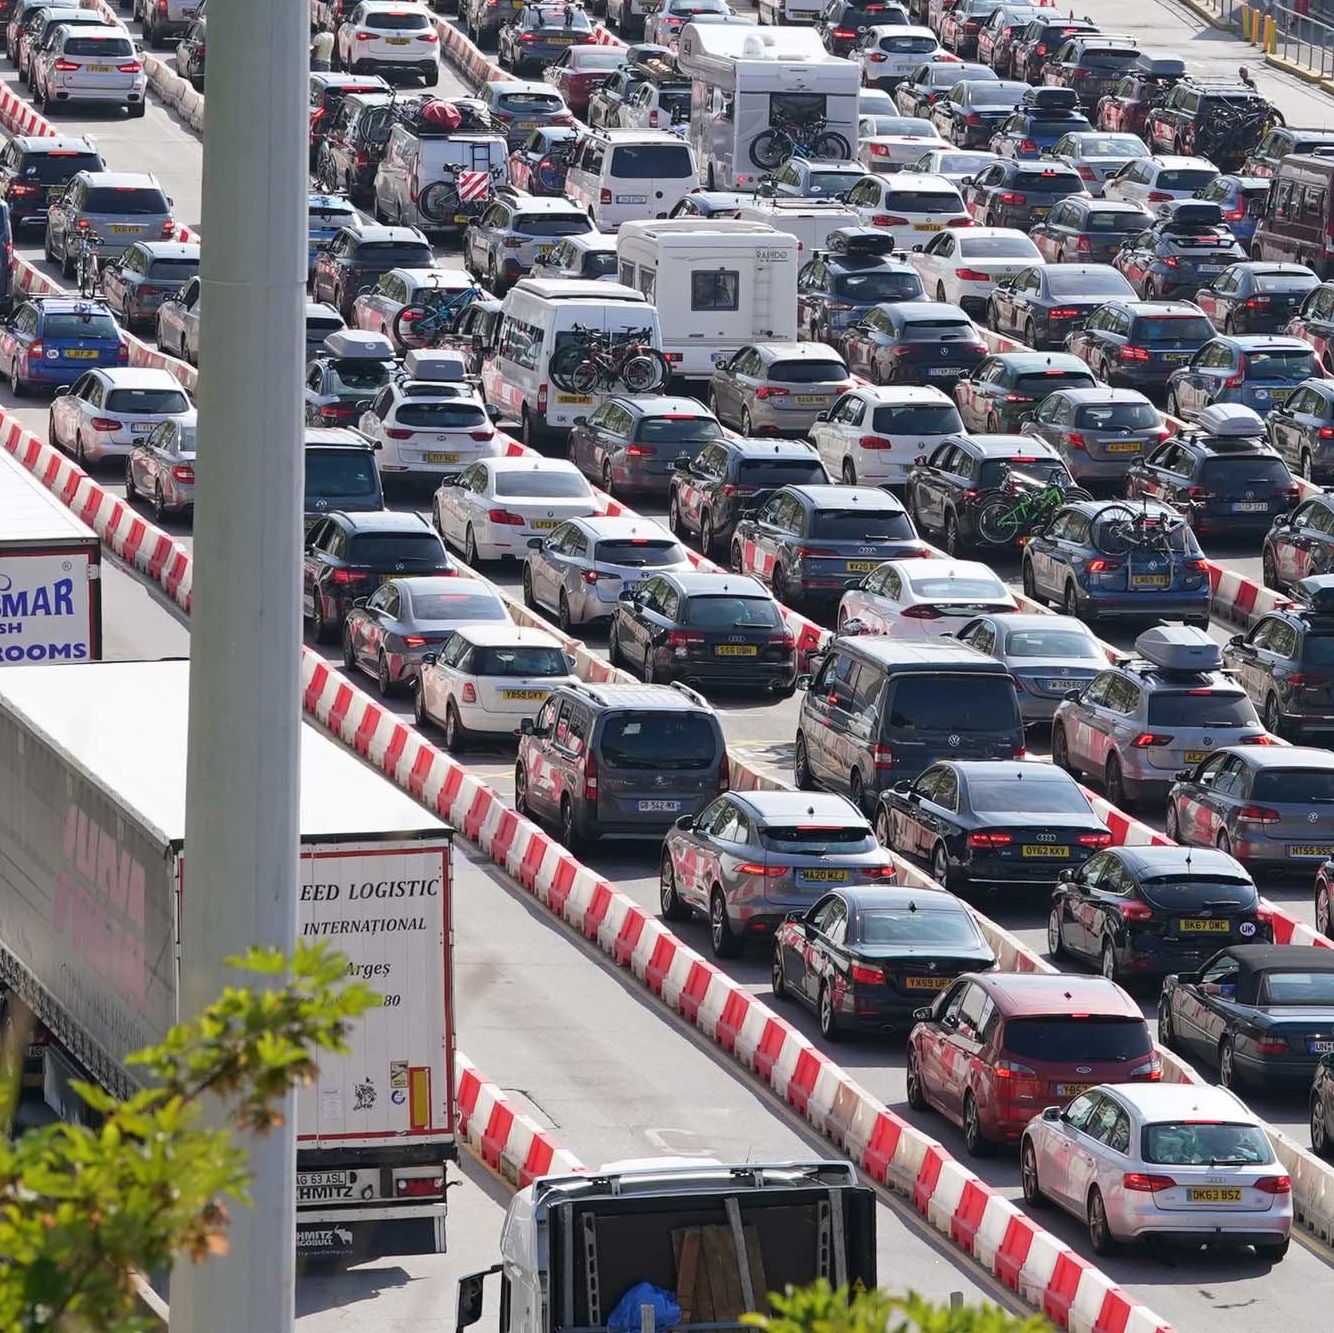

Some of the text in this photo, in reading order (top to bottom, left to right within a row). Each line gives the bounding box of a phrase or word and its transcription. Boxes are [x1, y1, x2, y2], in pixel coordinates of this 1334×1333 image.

[299, 878, 439, 902] EED LOGISTIC
[1184, 920, 1208, 931] BK67
[1241, 924, 1254, 934] UK
[311, 1174, 322, 1184] 63
[326, 1173, 344, 1184] ASL
[297, 1186, 354, 1199] HMITZ
[1193, 1189, 1241, 1201] DK63 BSZ
[297, 1231, 333, 1240] HMITZ
